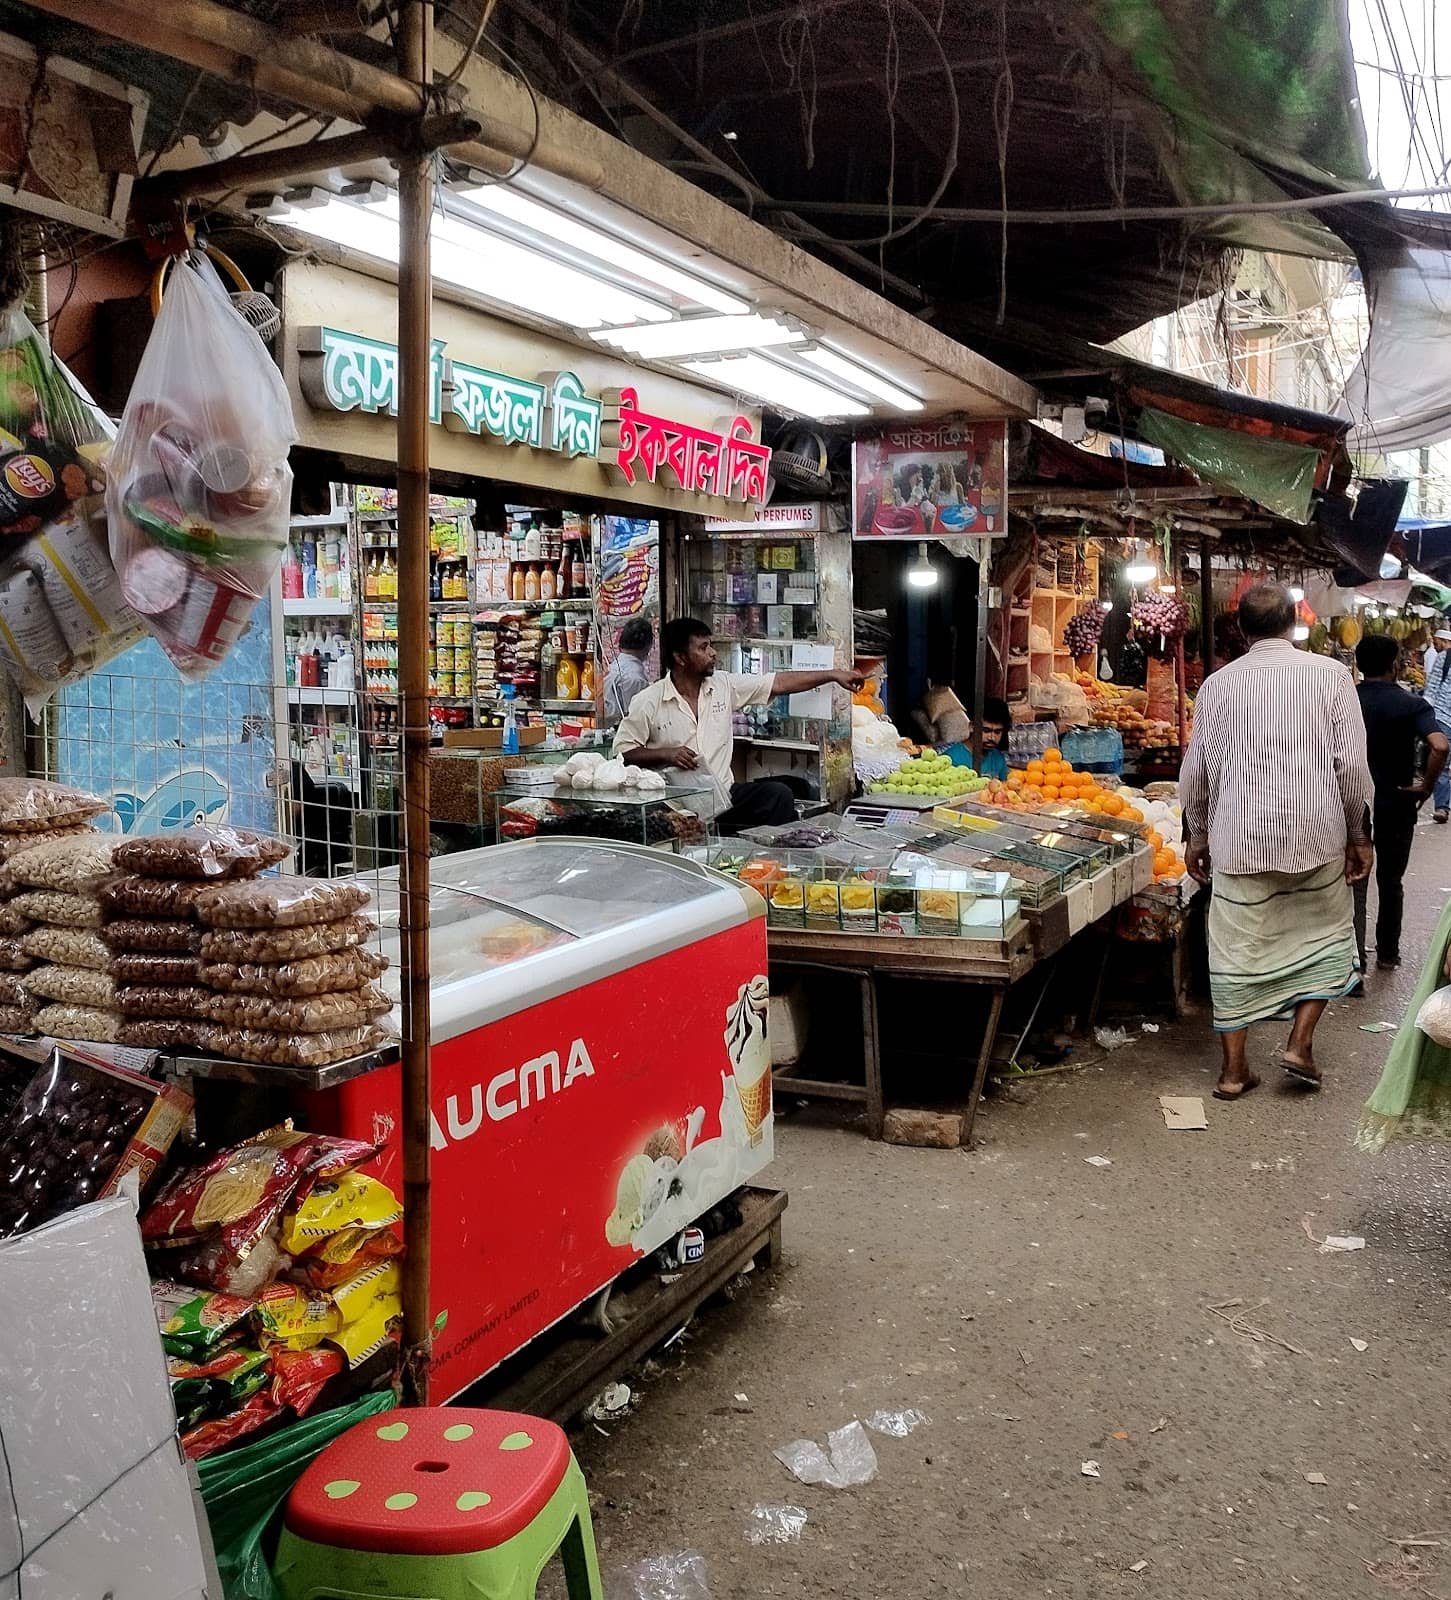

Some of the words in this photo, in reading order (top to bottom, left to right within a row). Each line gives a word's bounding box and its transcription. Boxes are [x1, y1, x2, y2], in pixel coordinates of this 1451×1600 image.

[451, 361, 544, 446] ফজল
[551, 371, 602, 458] দিন
[617, 386, 723, 496] ইকবাল
[725, 415, 771, 504] দিন
[763, 508, 813, 521] PERFUMES
[428, 1351, 452, 1373] CMA
[454, 1313, 503, 1355] COMPANY
[503, 1288, 540, 1320] LIMITED
